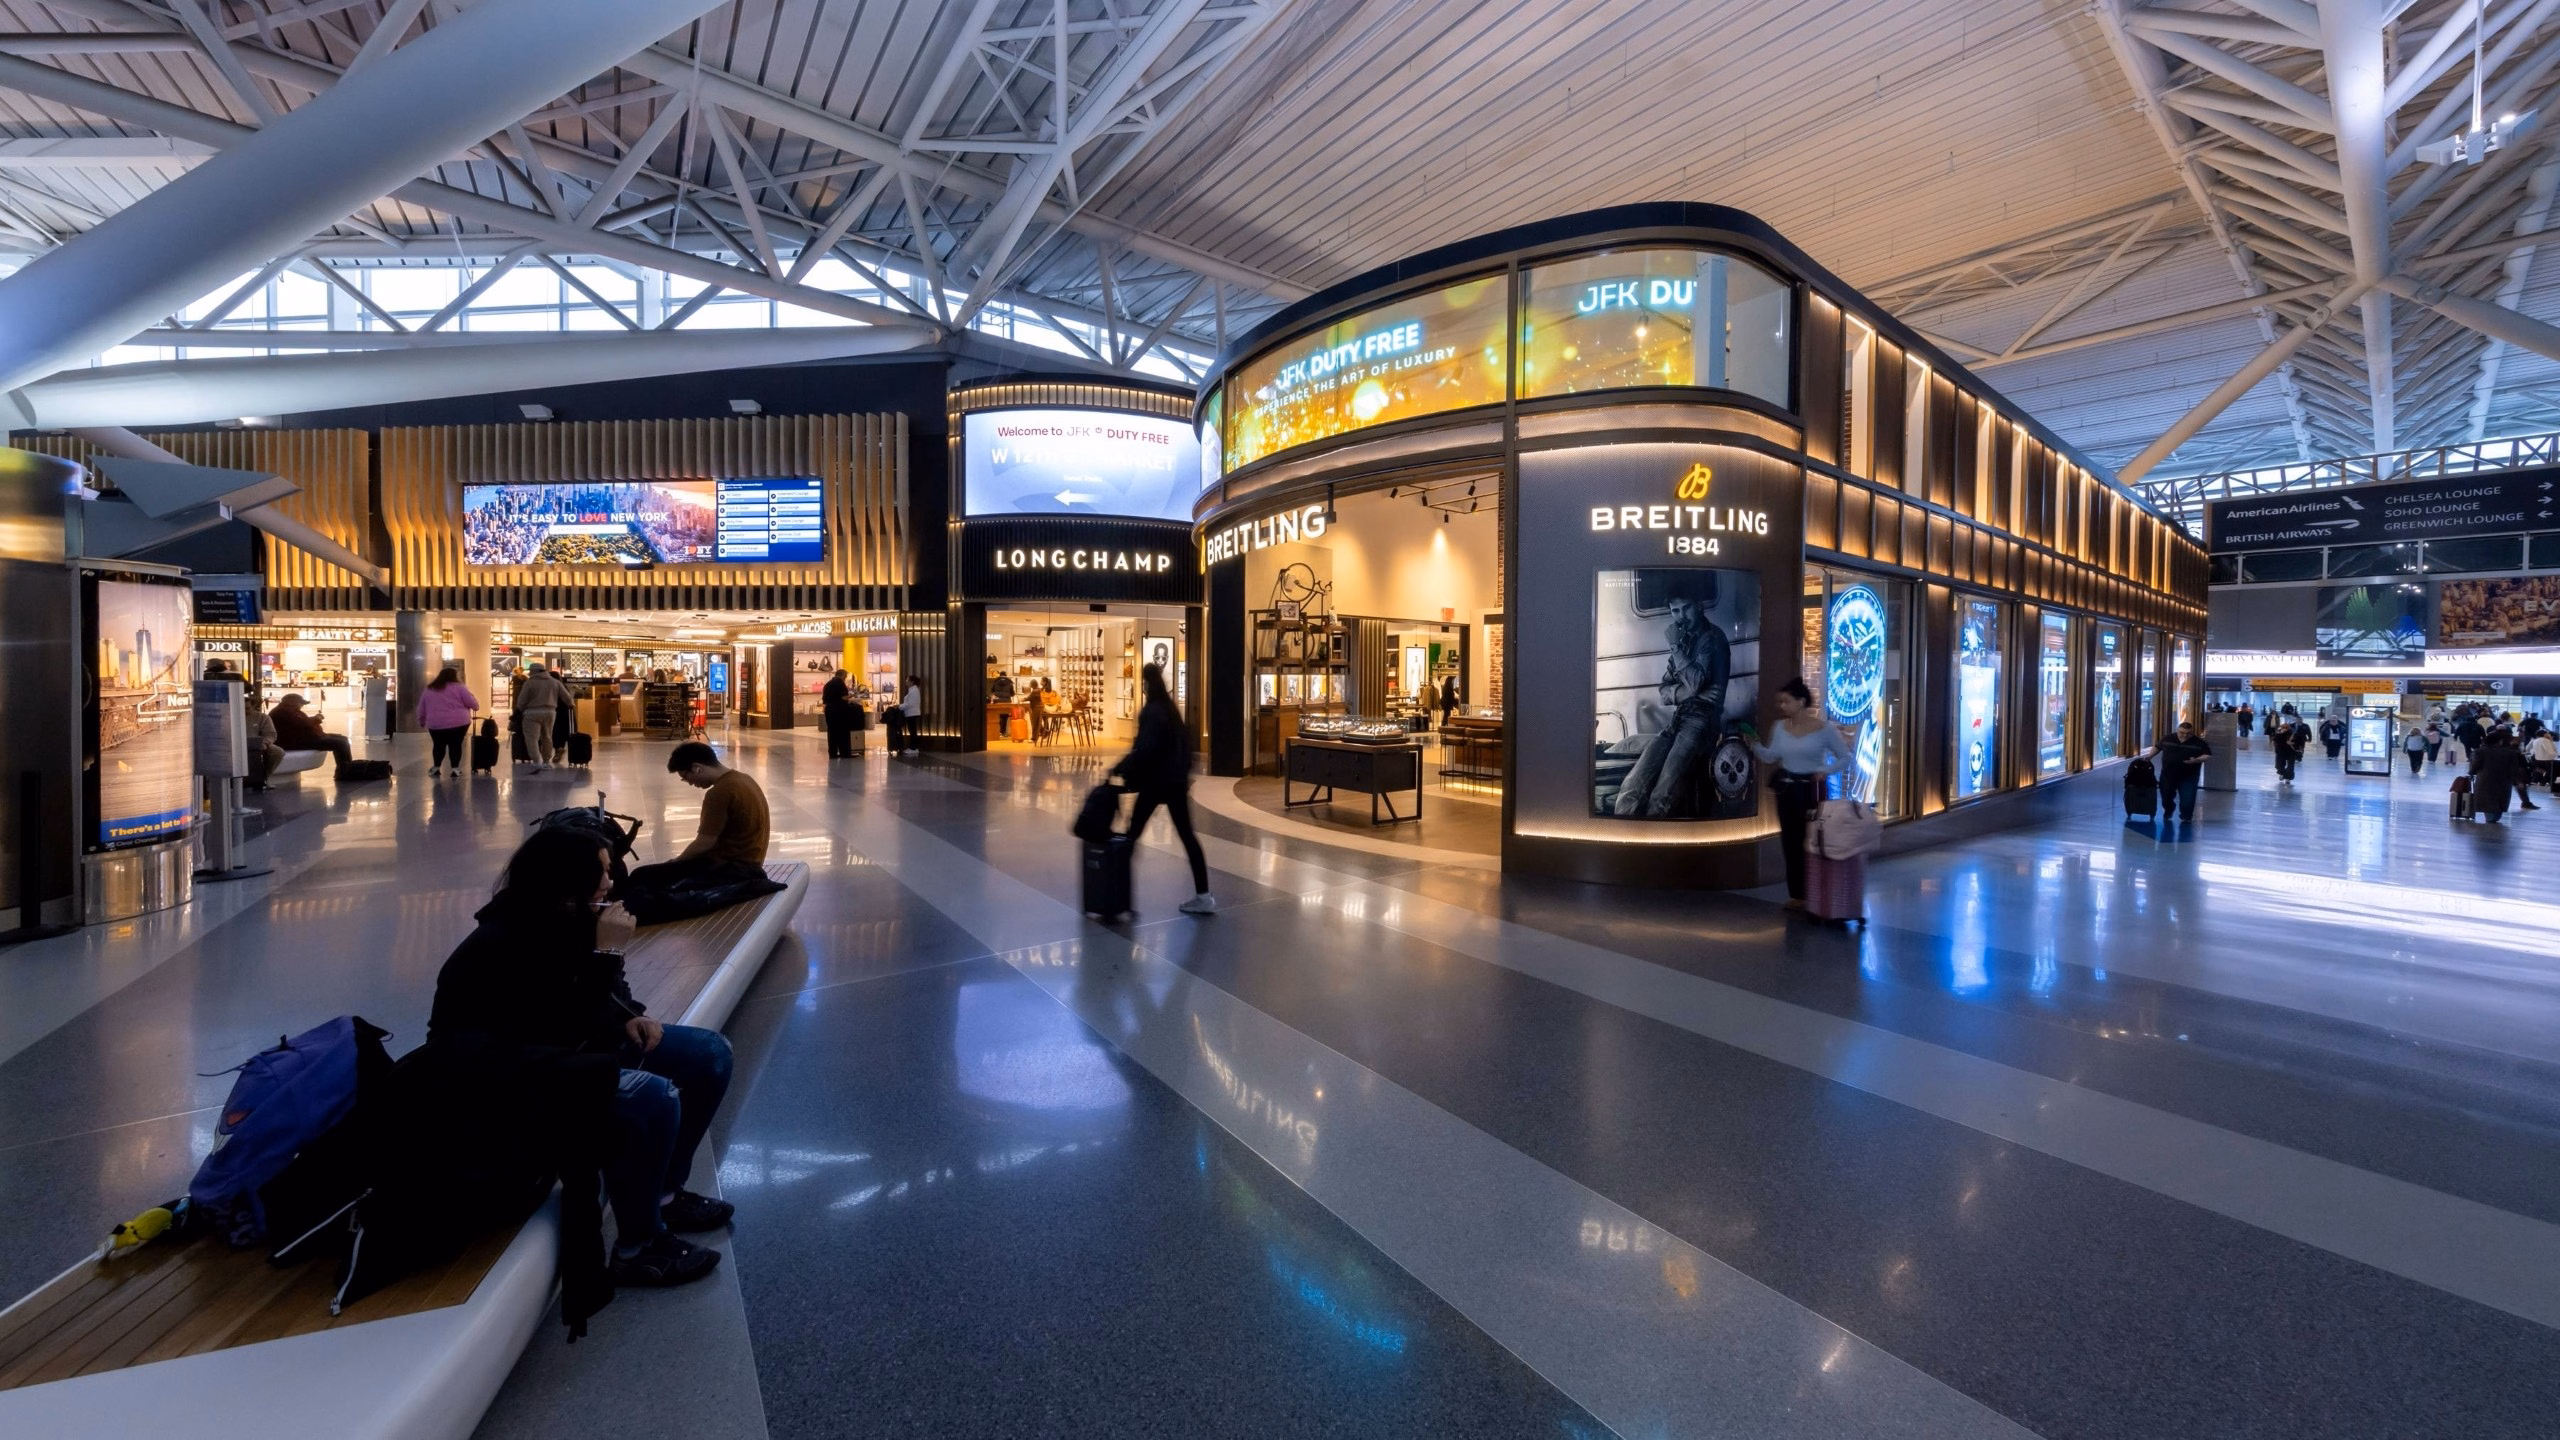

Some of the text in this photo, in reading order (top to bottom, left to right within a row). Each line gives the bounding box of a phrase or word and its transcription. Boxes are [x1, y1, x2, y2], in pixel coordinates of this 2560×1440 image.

[1579, 280, 1697, 312] JFK DU
[1276, 323, 1420, 390] JFK DUTY FREE
[1255, 346, 1456, 416] EXPERIENCE THE ART OF LUXURY
[998, 426, 1170, 444] Welcome to JFK DUTY FREE
[991, 448, 1007, 464] W
[2385, 486, 2502, 505] CHELSEA LOUNGE
[509, 512, 668, 523] IT'S EASY TO LOVE NEW YORK
[2227, 500, 2341, 520] American Airlines
[2384, 501, 2480, 518] SOHO LOUNGE
[1591, 506, 1768, 535] BREITLING
[2384, 511, 2525, 531] GREENWICH LOUNGE
[1207, 506, 1326, 566] BREITLING
[1668, 536, 1720, 555] 1884
[2225, 527, 2332, 545] BRITISH AIRWAYS
[997, 550, 1171, 573] LONGCHAMP
[298, 630, 352, 640] BEAUTY
[799, 621, 832, 633] JACOBS
[204, 642, 243, 652] DIOR
[109, 825, 153, 837] There's
